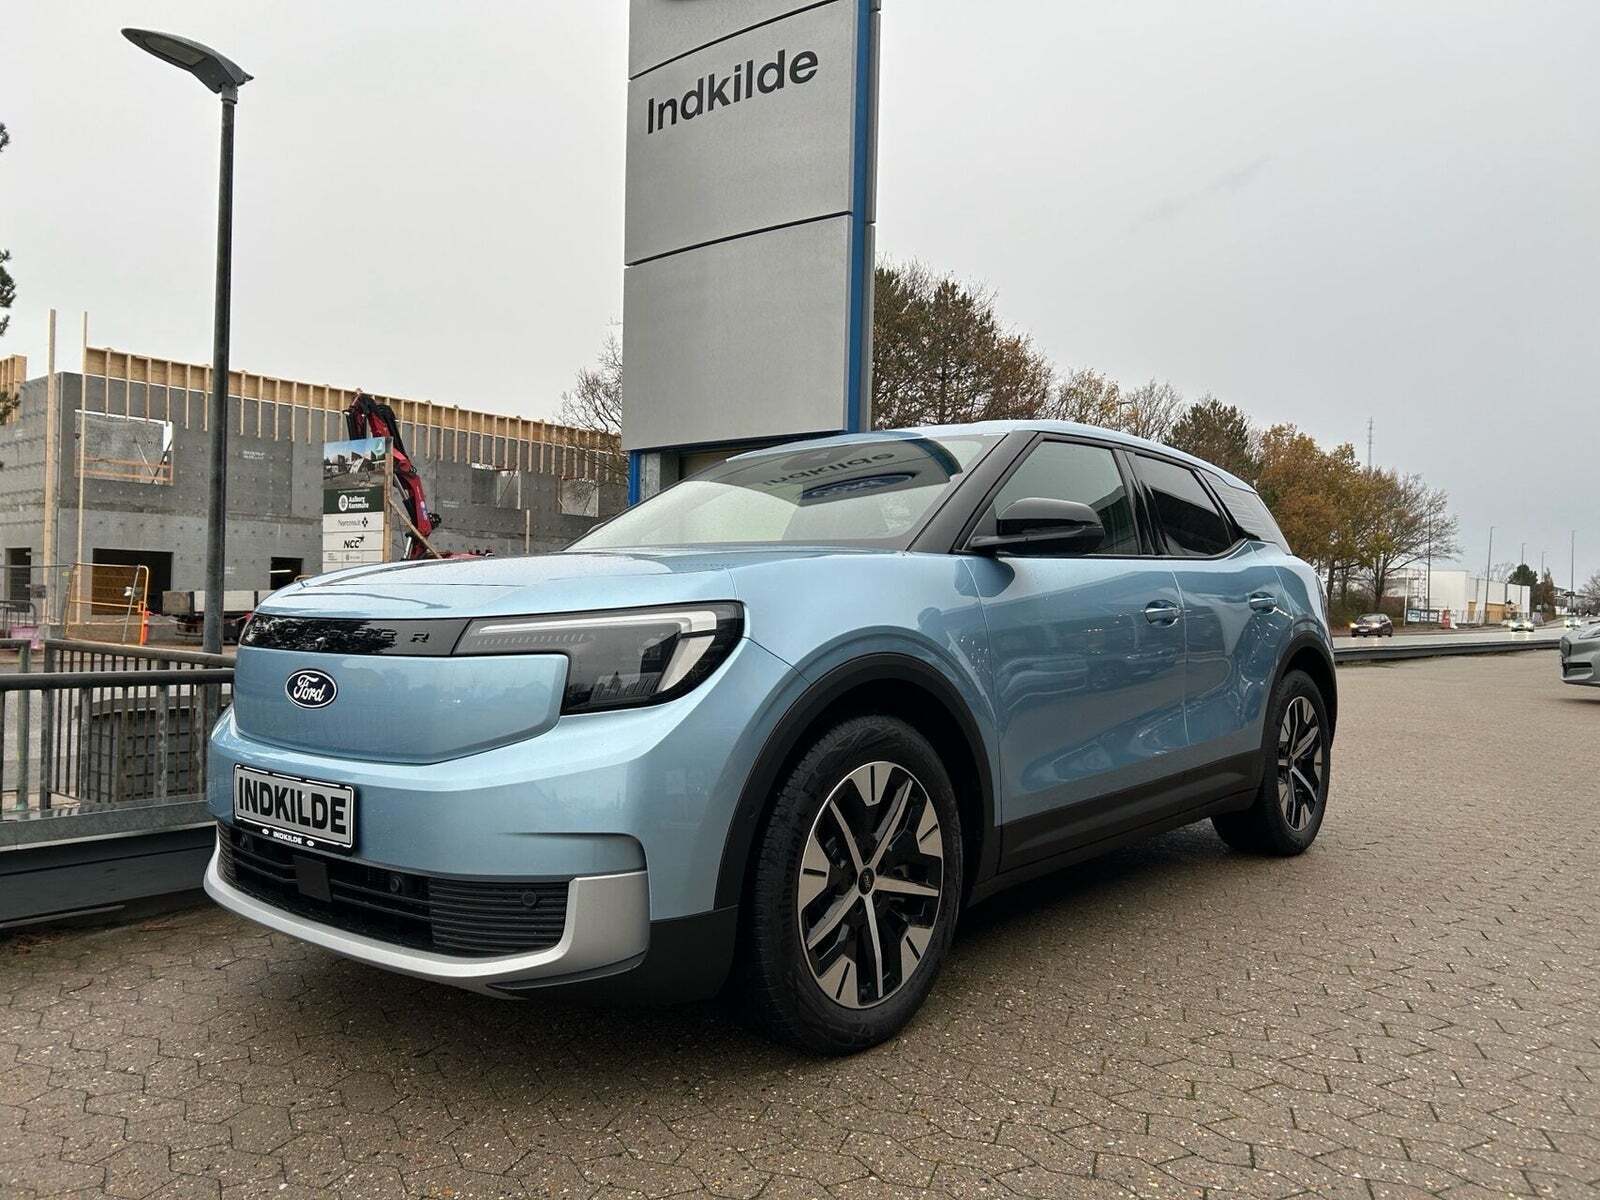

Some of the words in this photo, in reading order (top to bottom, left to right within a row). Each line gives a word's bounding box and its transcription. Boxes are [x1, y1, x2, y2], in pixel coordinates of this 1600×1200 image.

[647, 49, 818, 135] Indkilde
[343, 540, 360, 549] NCC
[293, 674, 326, 702] Ford
[239, 776, 346, 835] INDKILDE
[273, 831, 302, 844] INDKILDE
